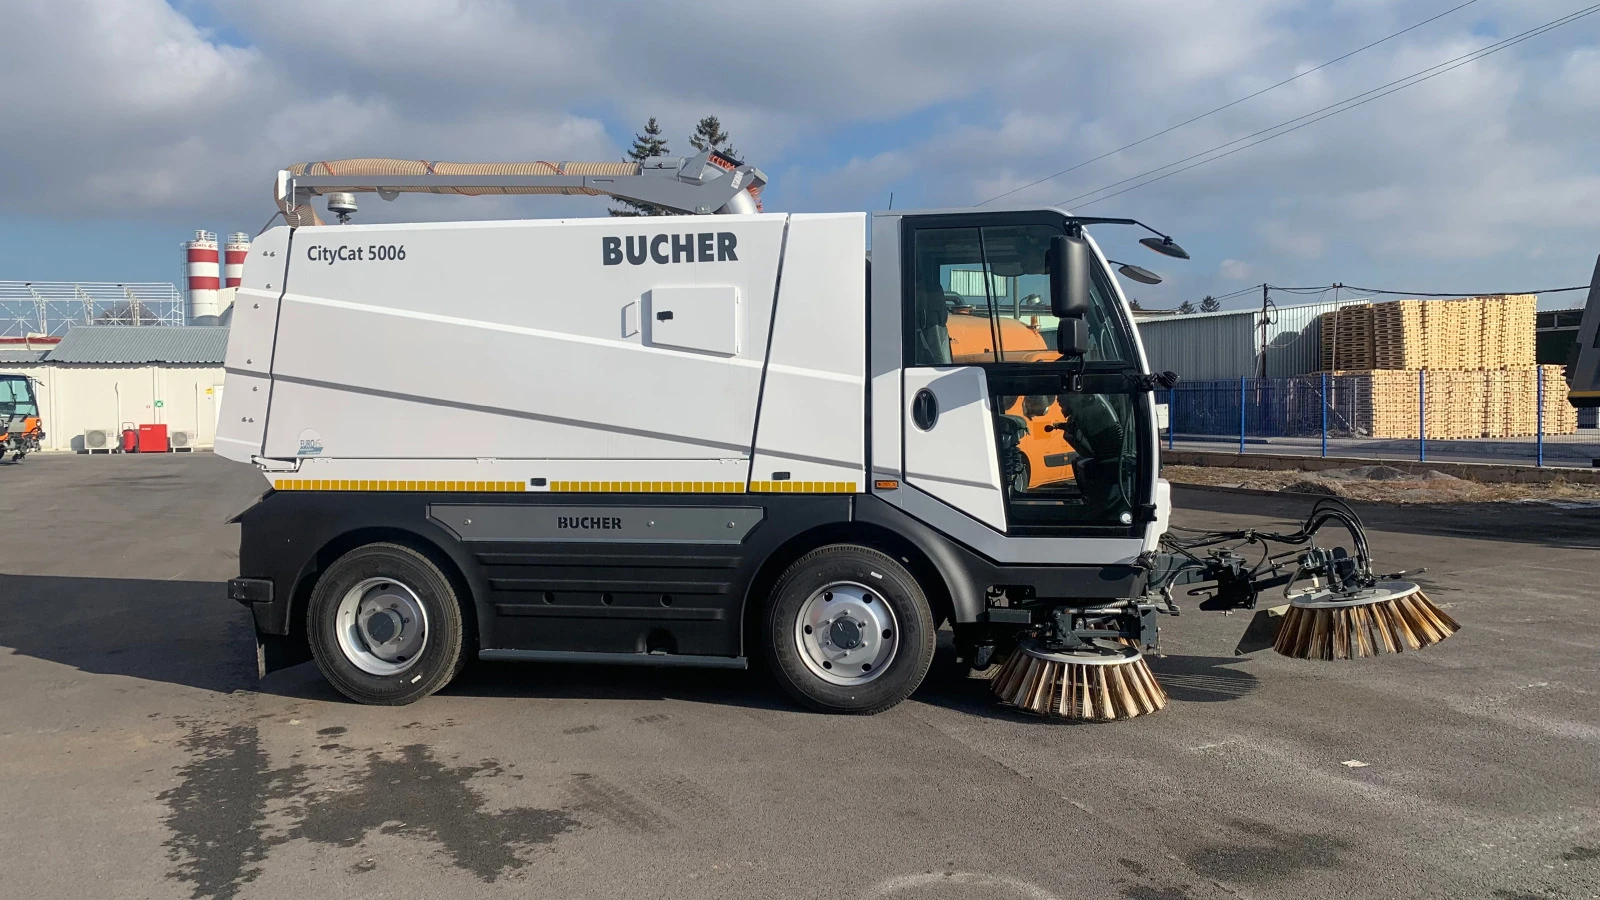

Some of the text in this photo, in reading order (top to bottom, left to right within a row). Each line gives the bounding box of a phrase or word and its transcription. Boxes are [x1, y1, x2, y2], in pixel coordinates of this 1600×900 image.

[307, 244, 406, 266] CityCat 5006
[602, 232, 739, 266] BUCHER
[557, 516, 622, 530] BUCHER
